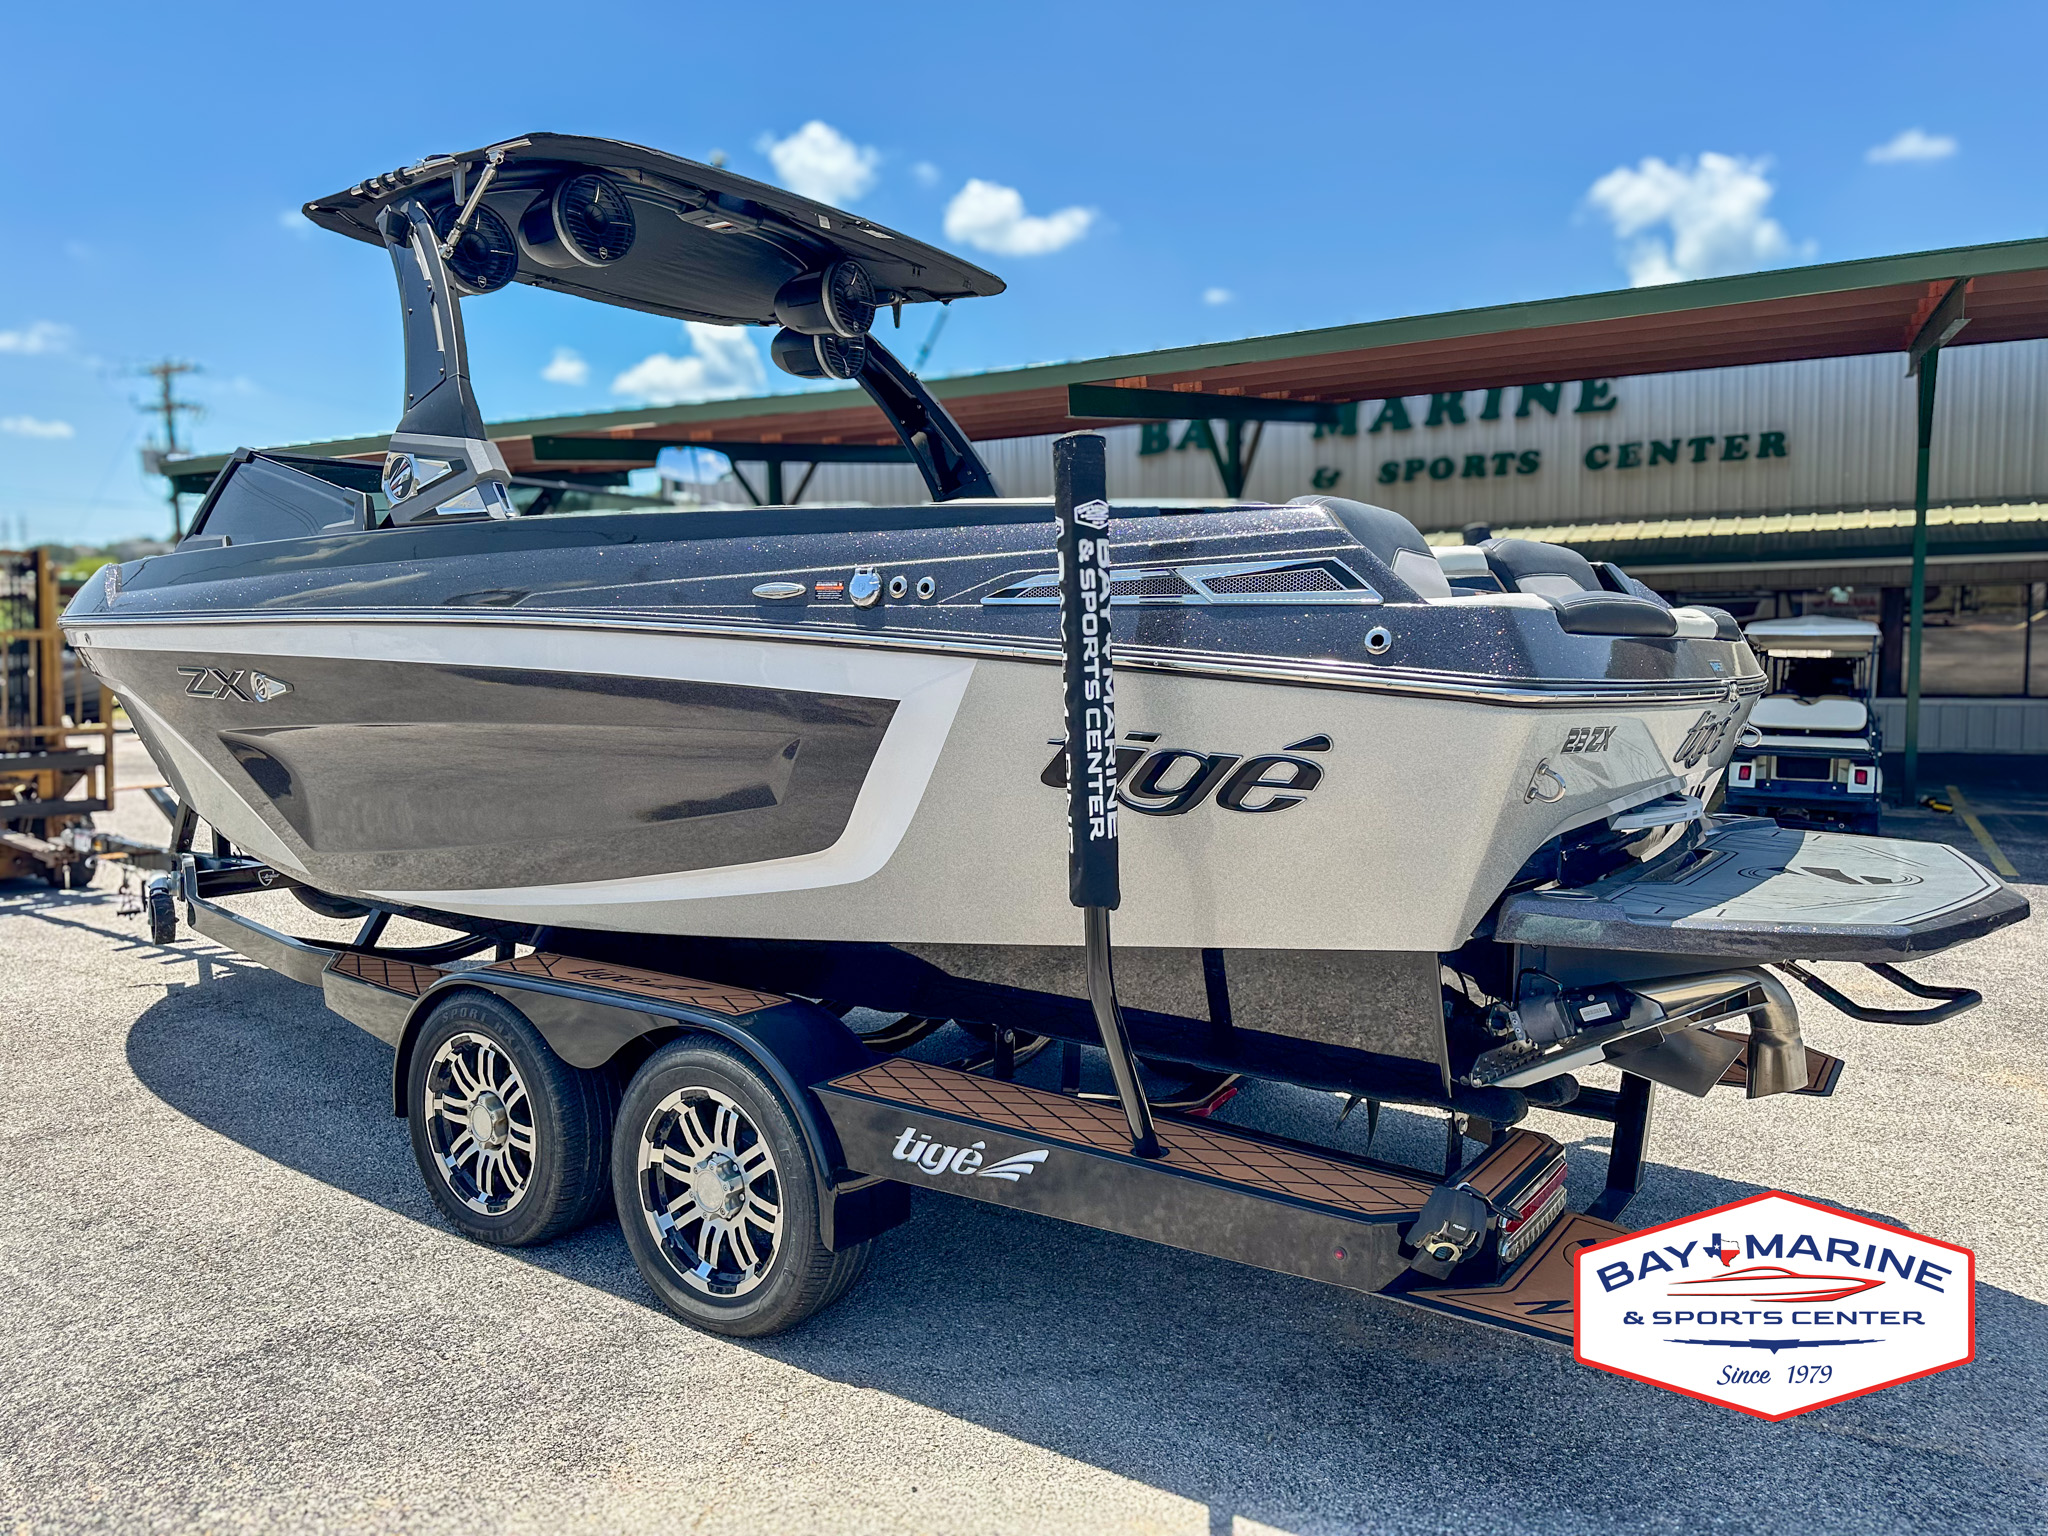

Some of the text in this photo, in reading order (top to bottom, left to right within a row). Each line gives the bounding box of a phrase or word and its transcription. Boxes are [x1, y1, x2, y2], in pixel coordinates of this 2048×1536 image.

[1139, 378, 1618, 455] BA MARINE
[1312, 431, 1788, 489] & SPORTS CENTER
[1078, 538, 1095, 563] &
[1079, 568, 1100, 701] SPORTS
[176, 665, 254, 703] ZX
[1086, 707, 1106, 842] CENTER
[1102, 667, 1118, 840] MARINE
[441, 1006, 488, 1024] SPORT
[892, 1126, 986, 1176] tigé
